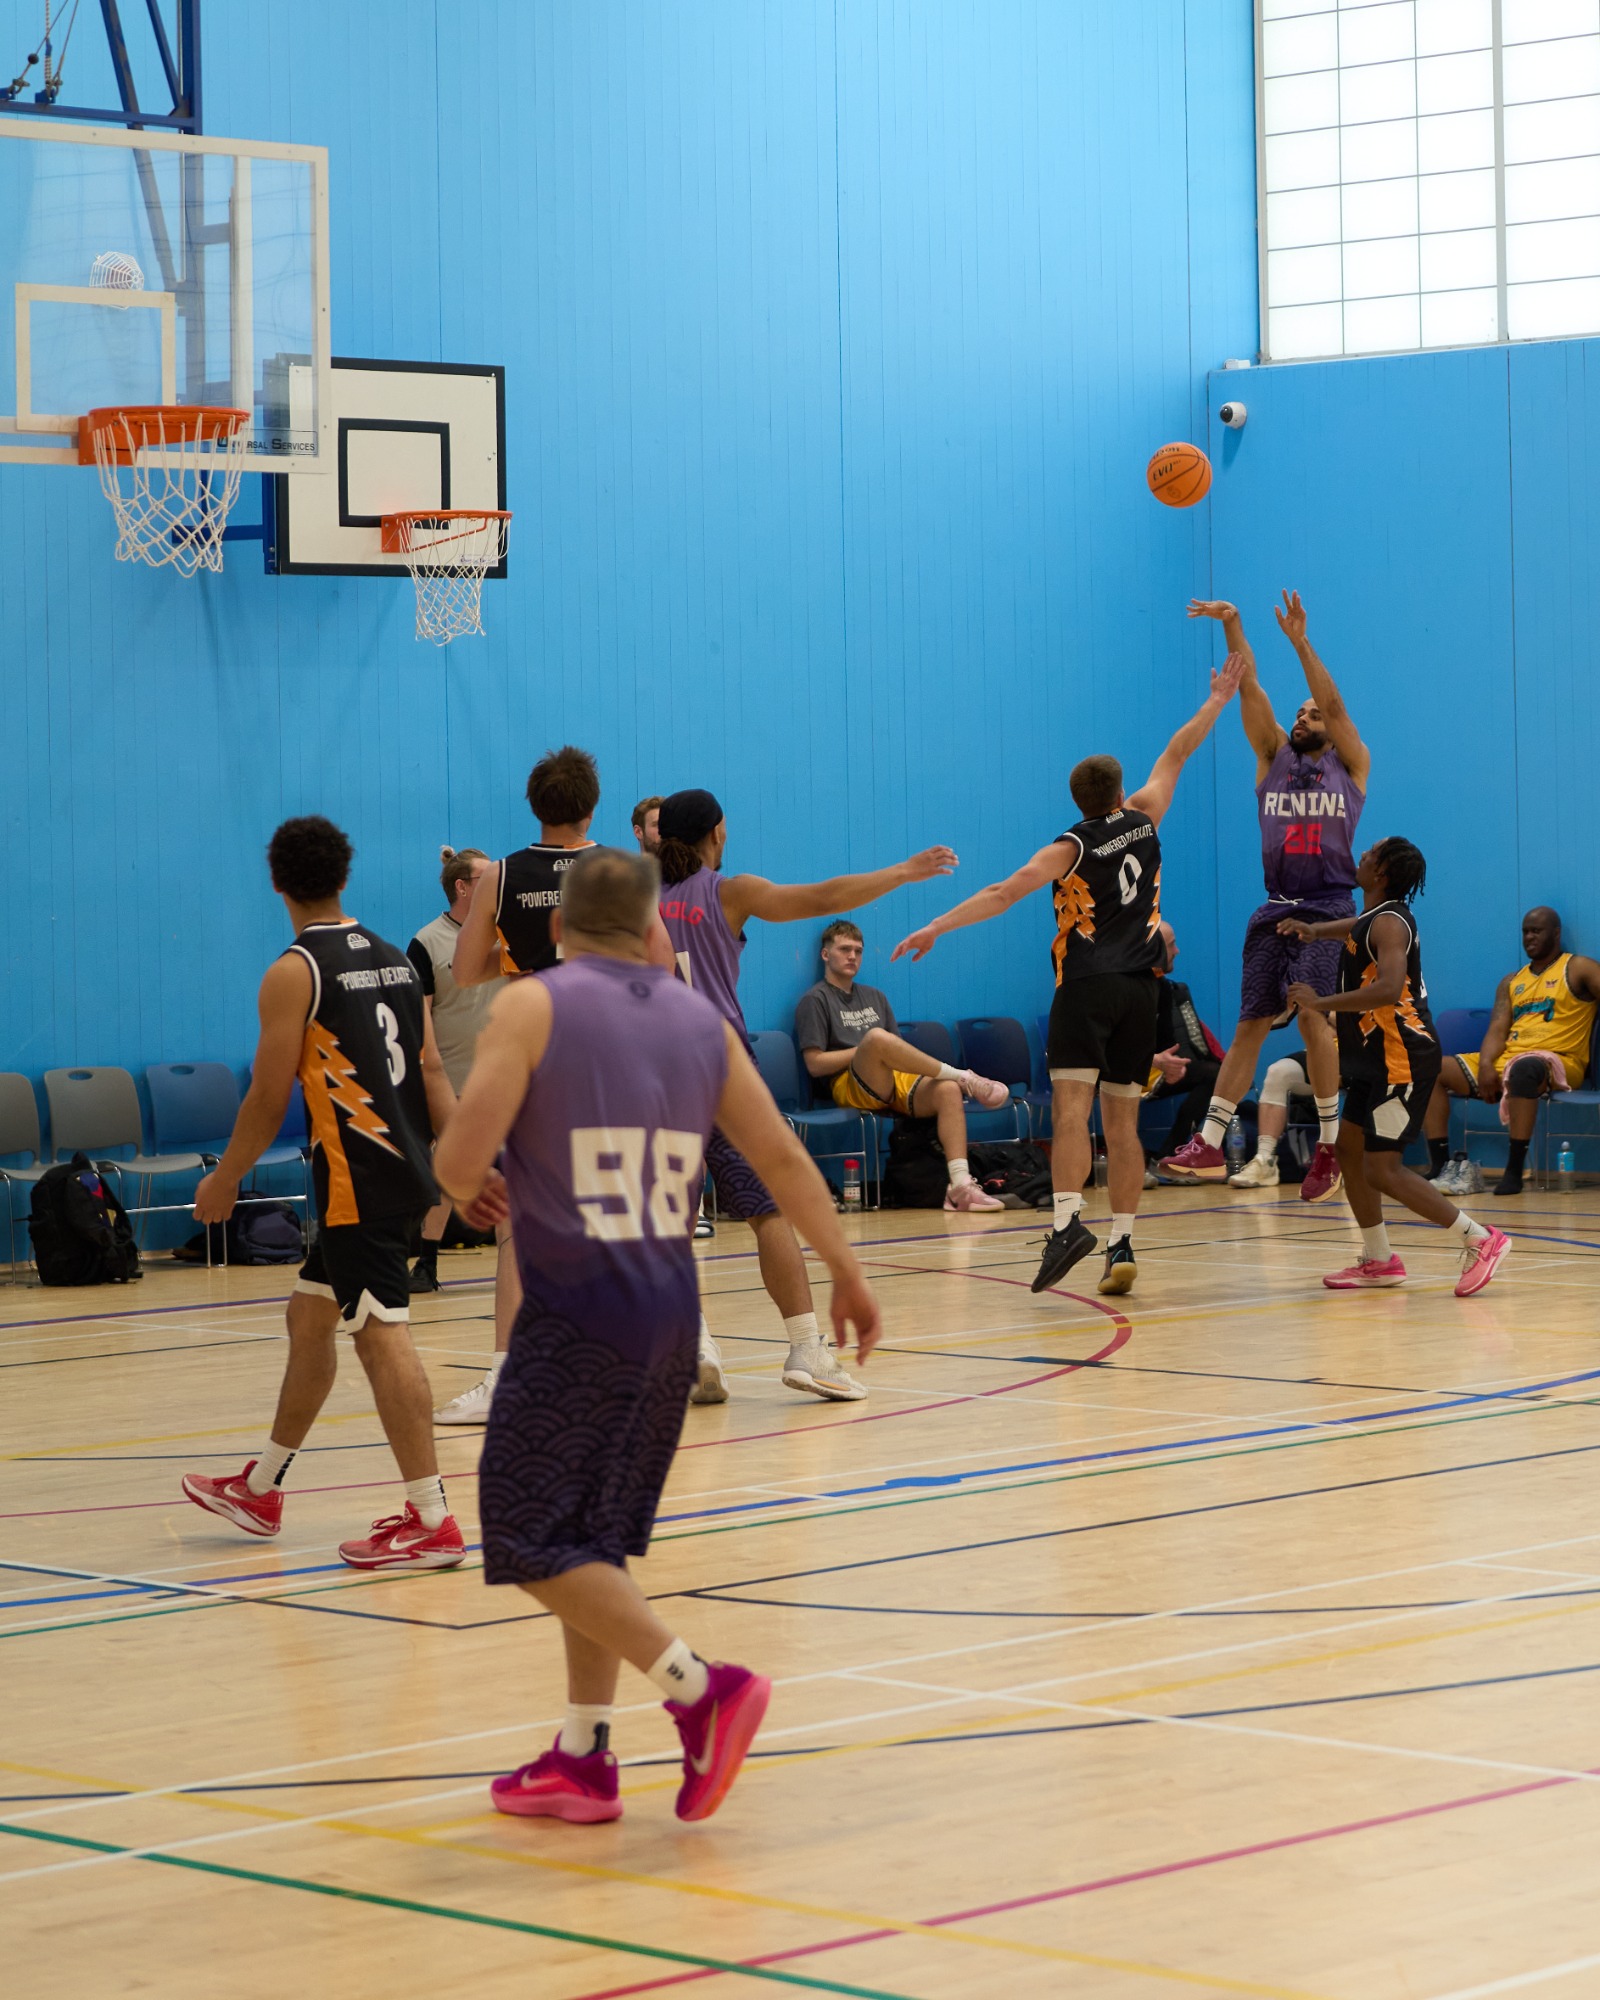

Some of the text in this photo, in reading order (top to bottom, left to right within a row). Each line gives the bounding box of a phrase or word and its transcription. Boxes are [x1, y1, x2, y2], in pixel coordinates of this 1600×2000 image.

[272, 438, 315, 452] SERVICES
[1119, 853, 1143, 905] 0
[659, 901, 705, 926] OLO
[376, 1002, 406, 1087] 3
[570, 1126, 703, 1242] 98
